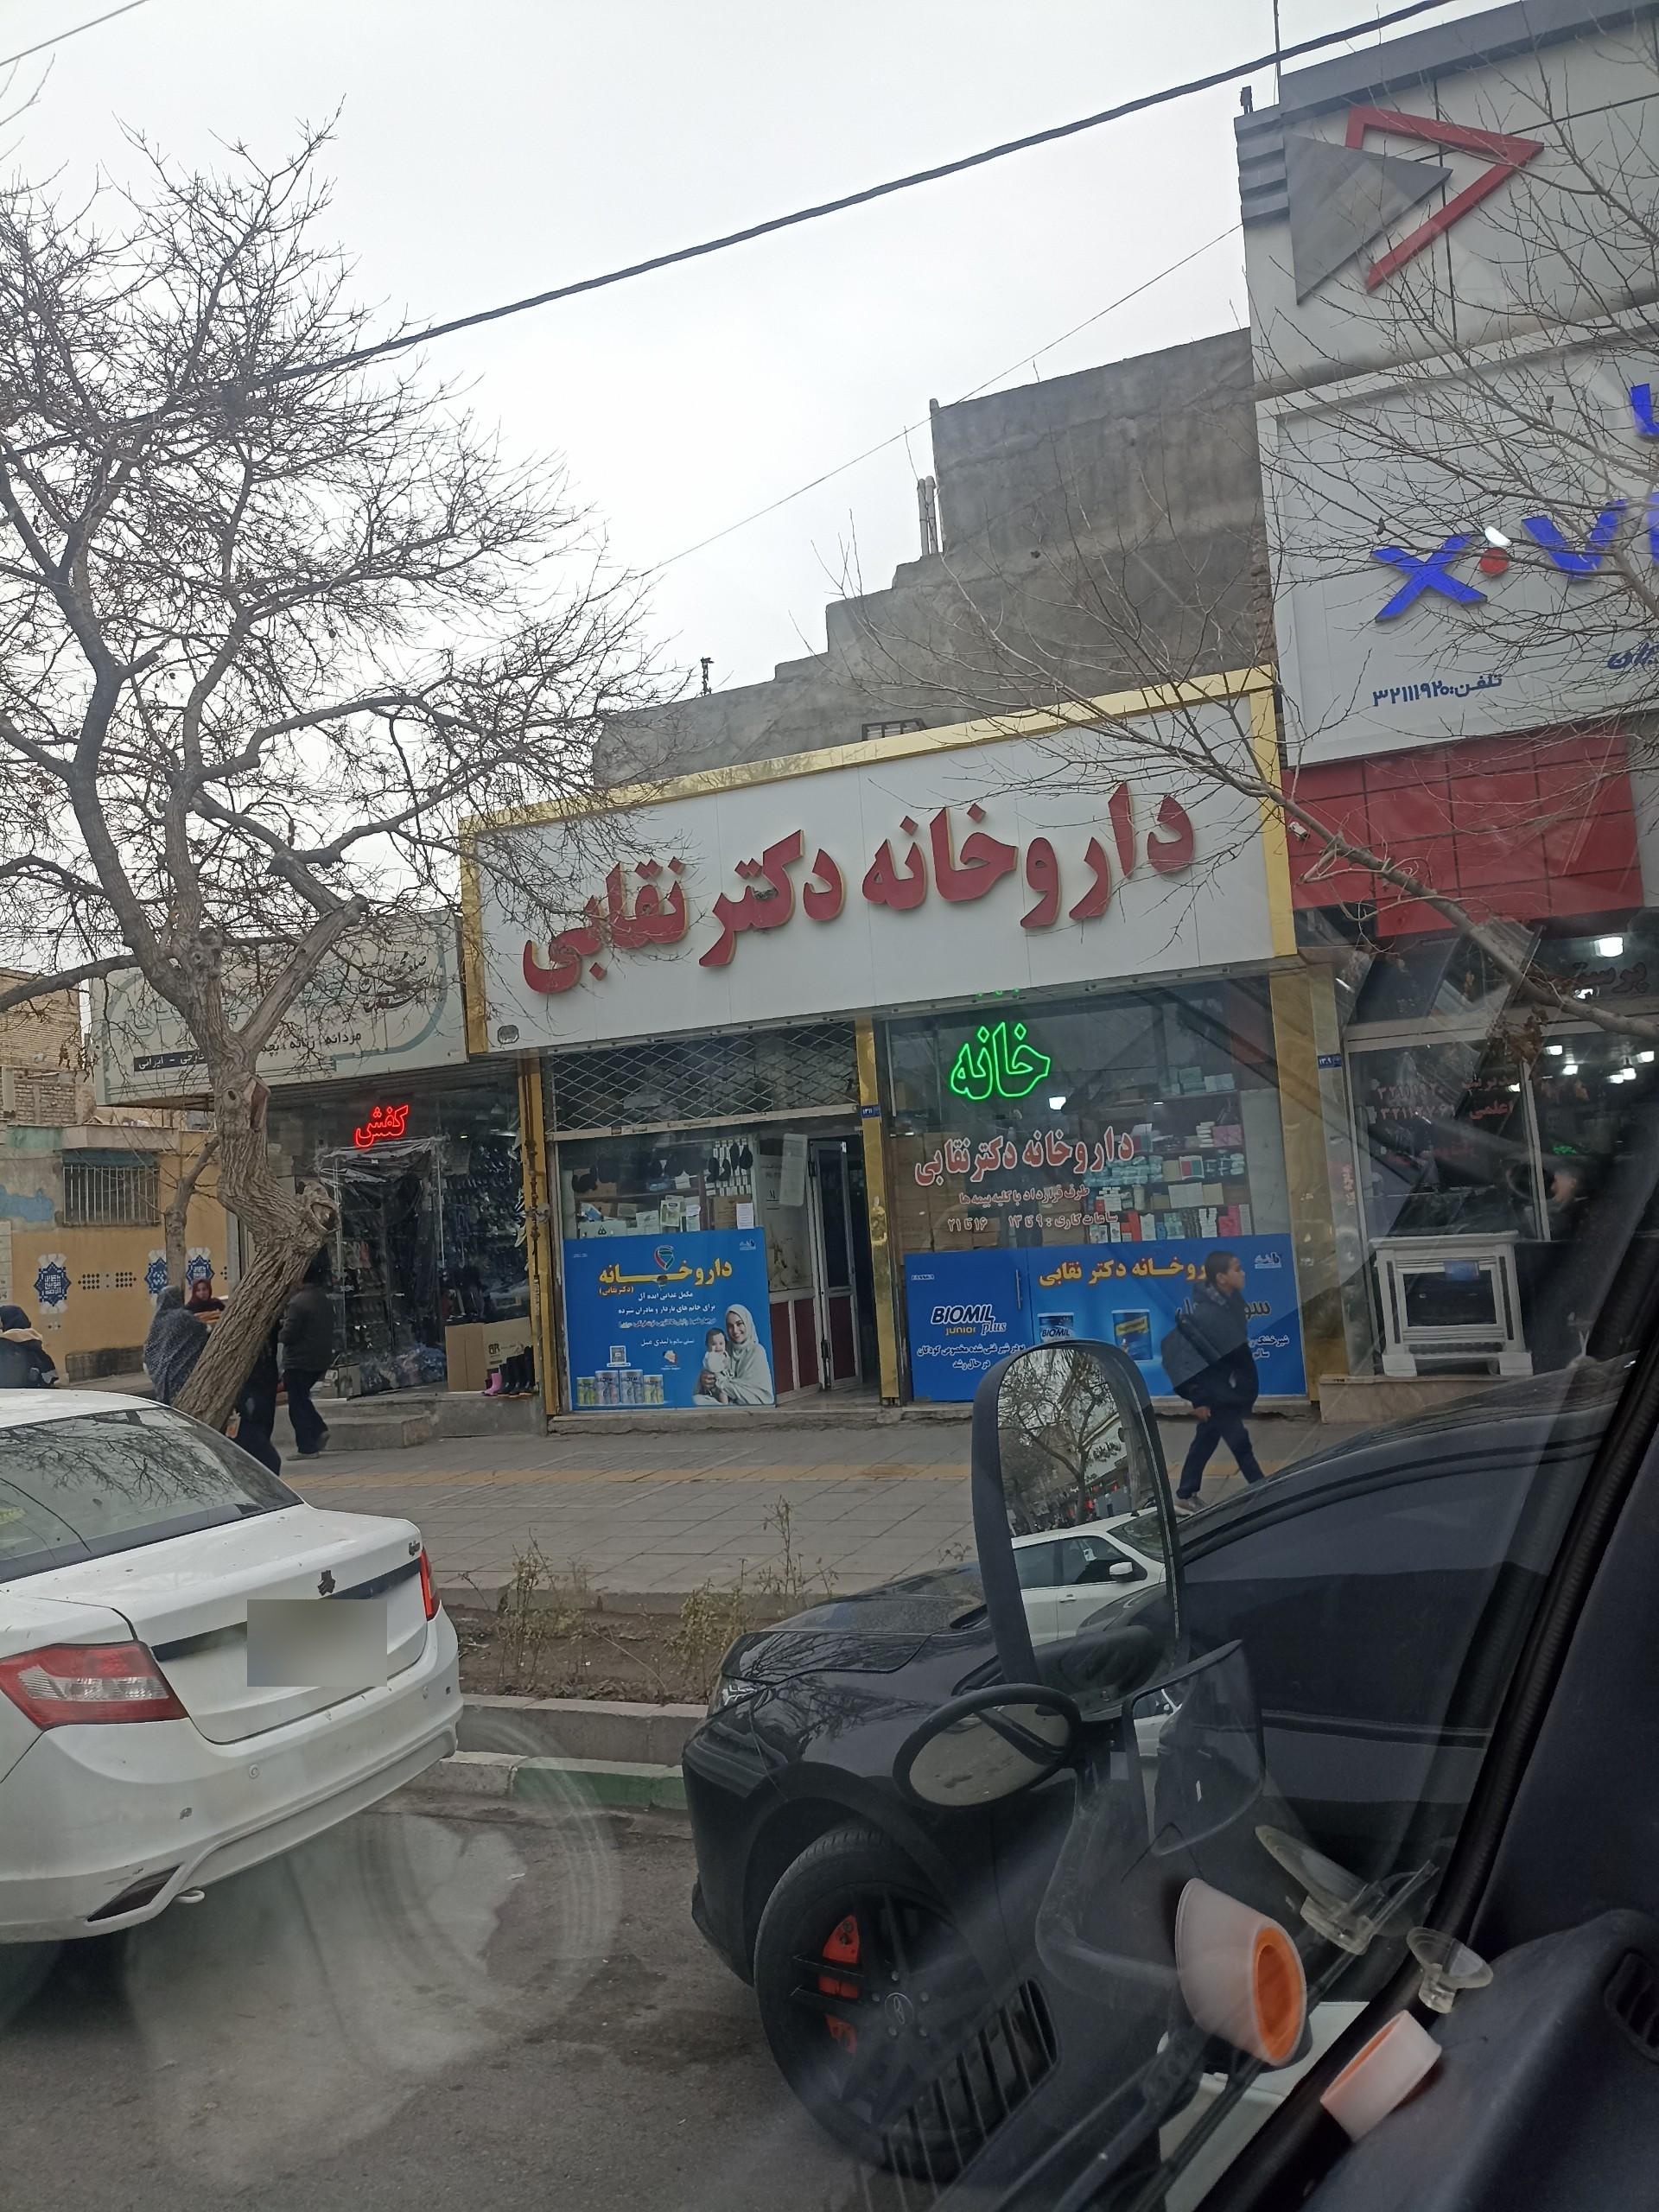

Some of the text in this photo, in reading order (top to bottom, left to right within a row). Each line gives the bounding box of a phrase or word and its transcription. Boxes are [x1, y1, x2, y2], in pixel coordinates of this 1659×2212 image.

[862, 781, 1194, 930] داروخانه
[698, 829, 845, 967] دکتر
[523, 856, 690, 994] نقابی
[289, 1036, 315, 1050] زنانه
[326, 1032, 361, 1046] مردانه
[138, 1056, 164, 1070] ایرانی
[950, 1021, 1051, 1100] خانه
[354, 1103, 409, 1147] کفش
[915, 1126, 1134, 1186] داروخانه دکتر نقابی
[1013, 1190, 1021, 1206] با
[1023, 1185, 1063, 1203] قرارداد
[1064, 1184, 1090, 1200] طرف
[971, 1194, 991, 1208] بیمه
[1054, 1213, 1082, 1230] کاری
[1082, 1211, 1118, 1225] ساعات
[599, 1257, 734, 1286] داروخانه
[1038, 1256, 1207, 1287] روخانه دکتر نقابی
[931, 1304, 995, 1325] BIOMIL
[981, 1321, 1007, 1336] plus
[1041, 1327, 1071, 1338] BIOMIL
[917, 1344, 941, 1357] کودکان
[941, 1344, 969, 1356] مخصوص
[969, 1344, 982, 1353] شده
[997, 1343, 1009, 1354] شیر
[952, 1358, 991, 1370] در حال رشد
